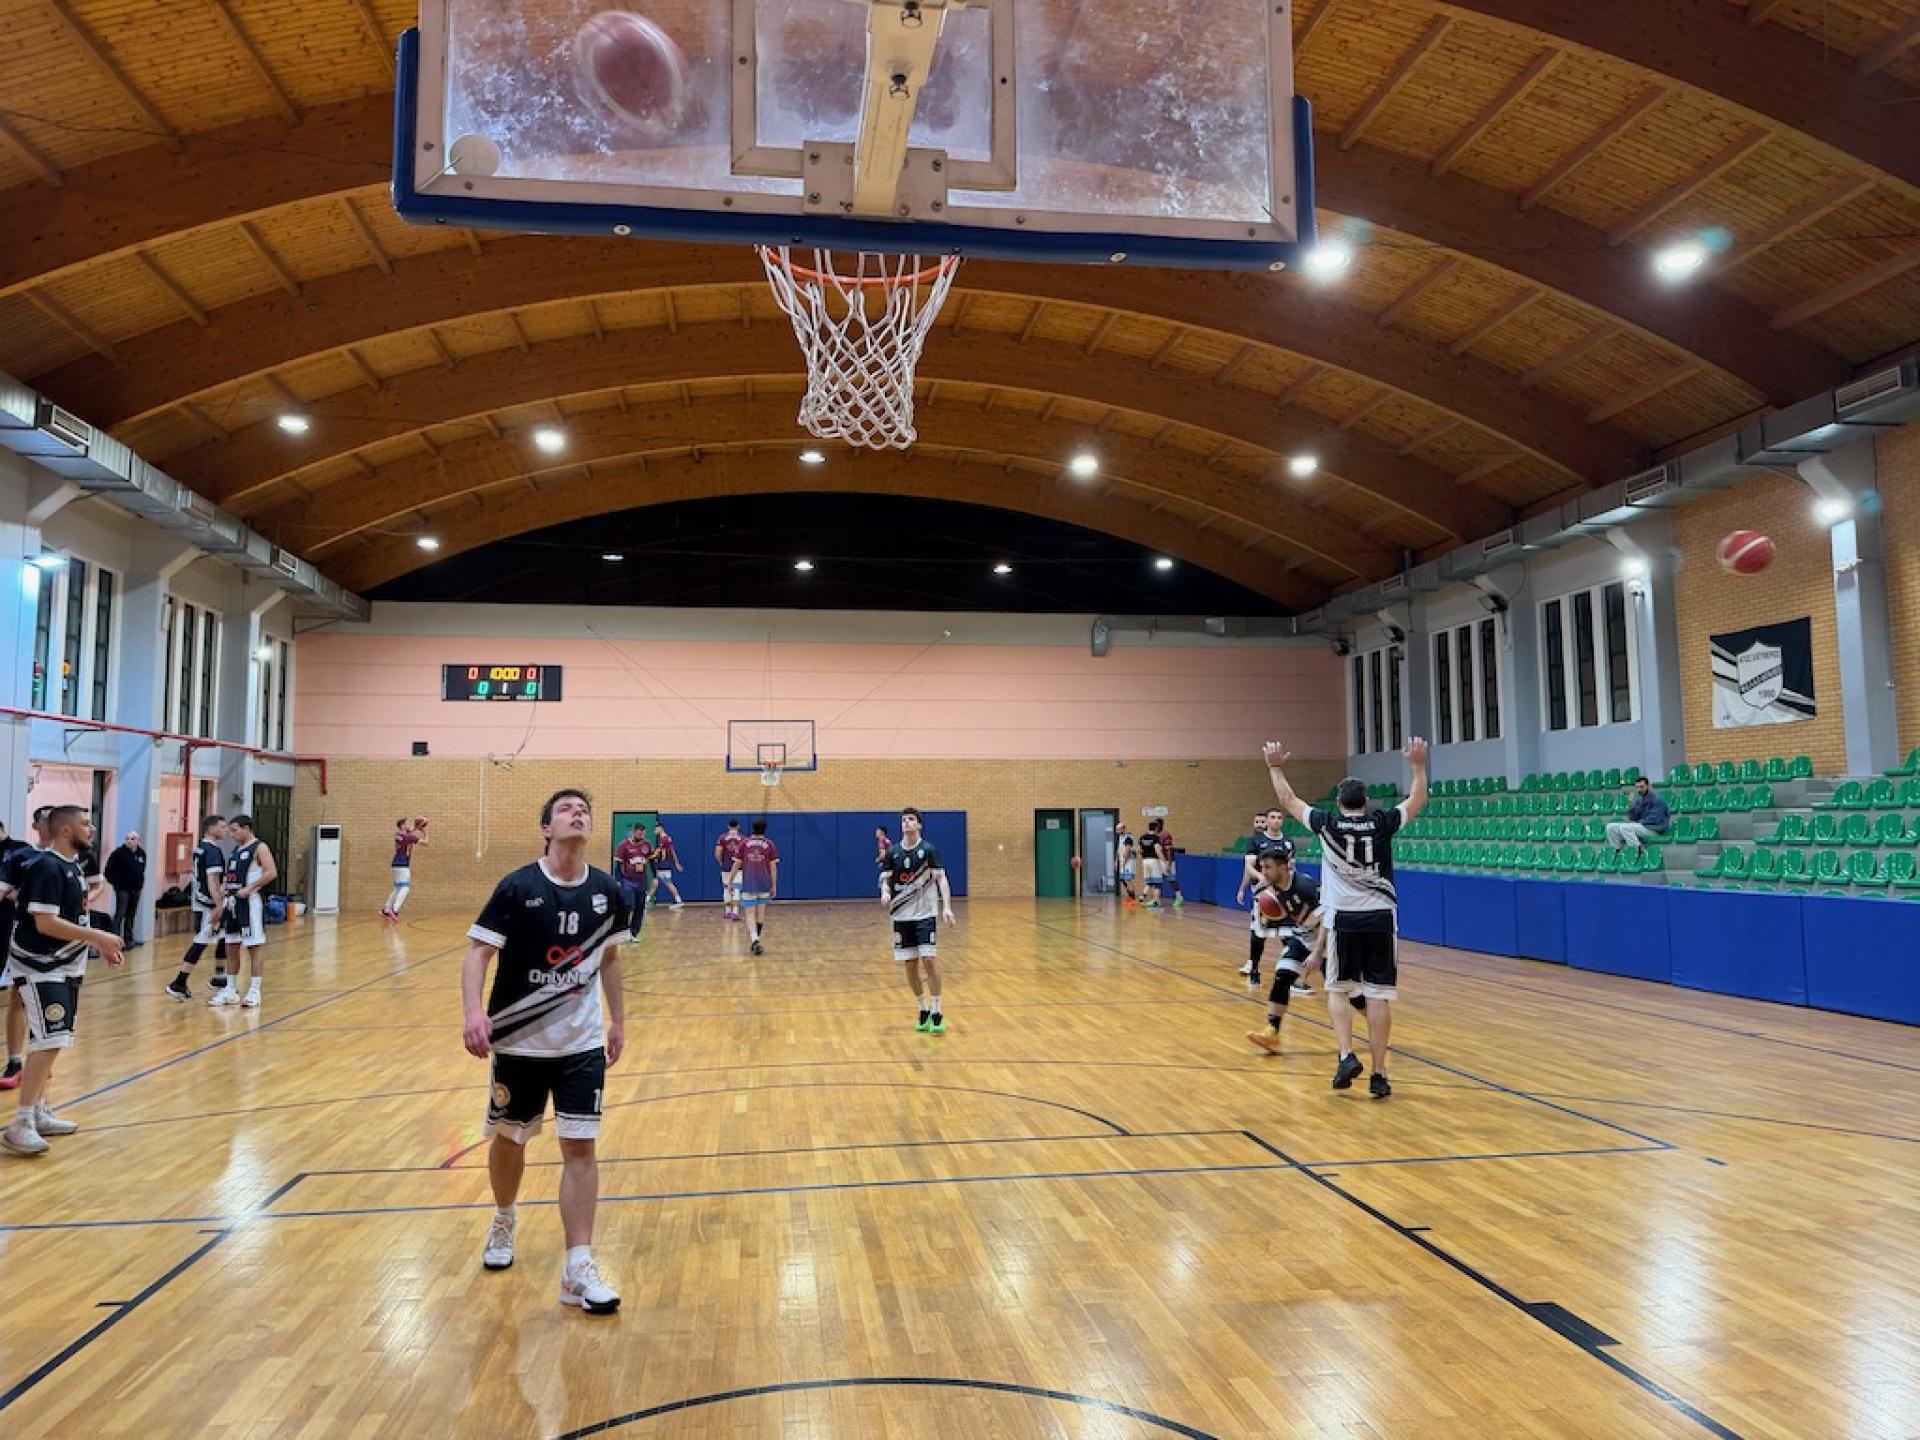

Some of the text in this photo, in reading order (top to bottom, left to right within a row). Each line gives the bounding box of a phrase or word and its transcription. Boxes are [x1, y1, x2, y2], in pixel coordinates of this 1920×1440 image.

[468, 667, 478, 680] 0
[526, 667, 537, 680] 0
[1342, 833, 1374, 864] 11
[557, 911, 580, 935] 18
